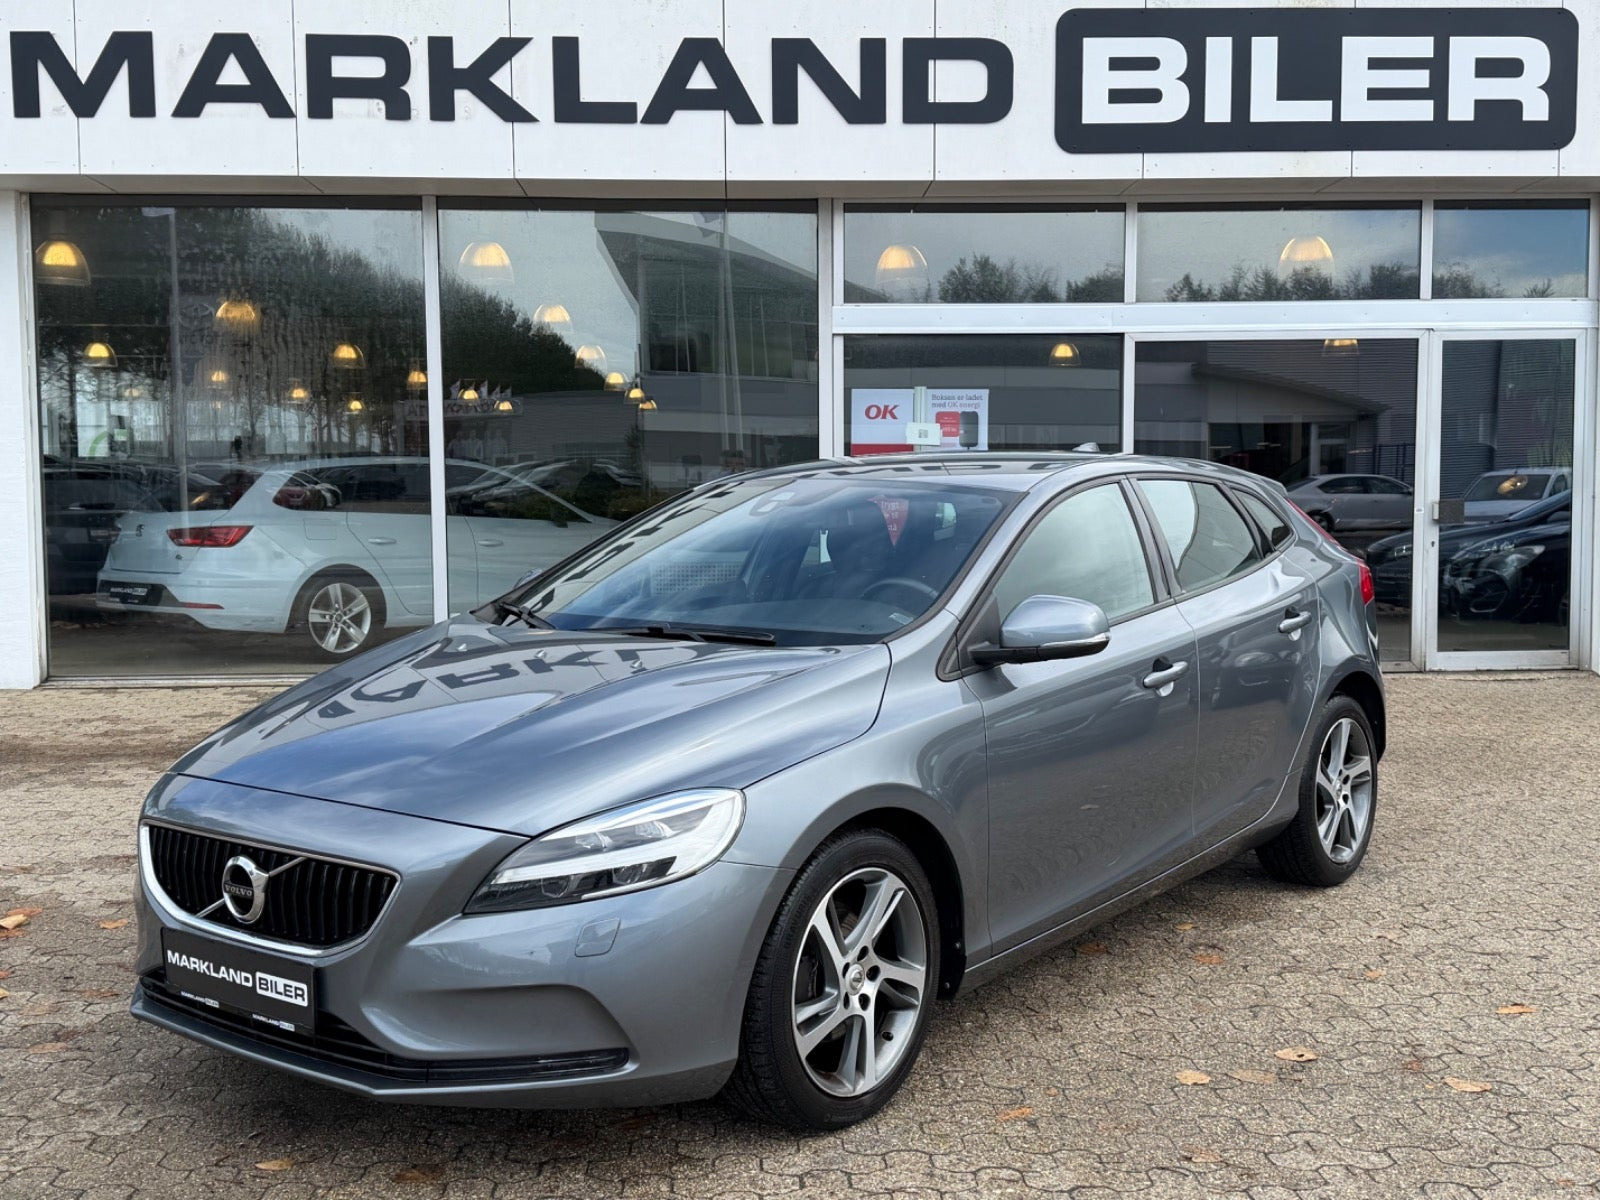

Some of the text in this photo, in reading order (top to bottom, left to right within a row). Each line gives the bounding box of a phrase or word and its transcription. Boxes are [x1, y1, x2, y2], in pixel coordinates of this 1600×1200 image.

[9, 31, 1551, 125] MARKLAND BILER
[931, 393, 955, 401] Boksen
[865, 405, 899, 419] OK
[224, 883, 253, 897] VOLVO
[167, 949, 306, 1002] MARKLAND BILER
[180, 991, 205, 1003] MARKLAND
